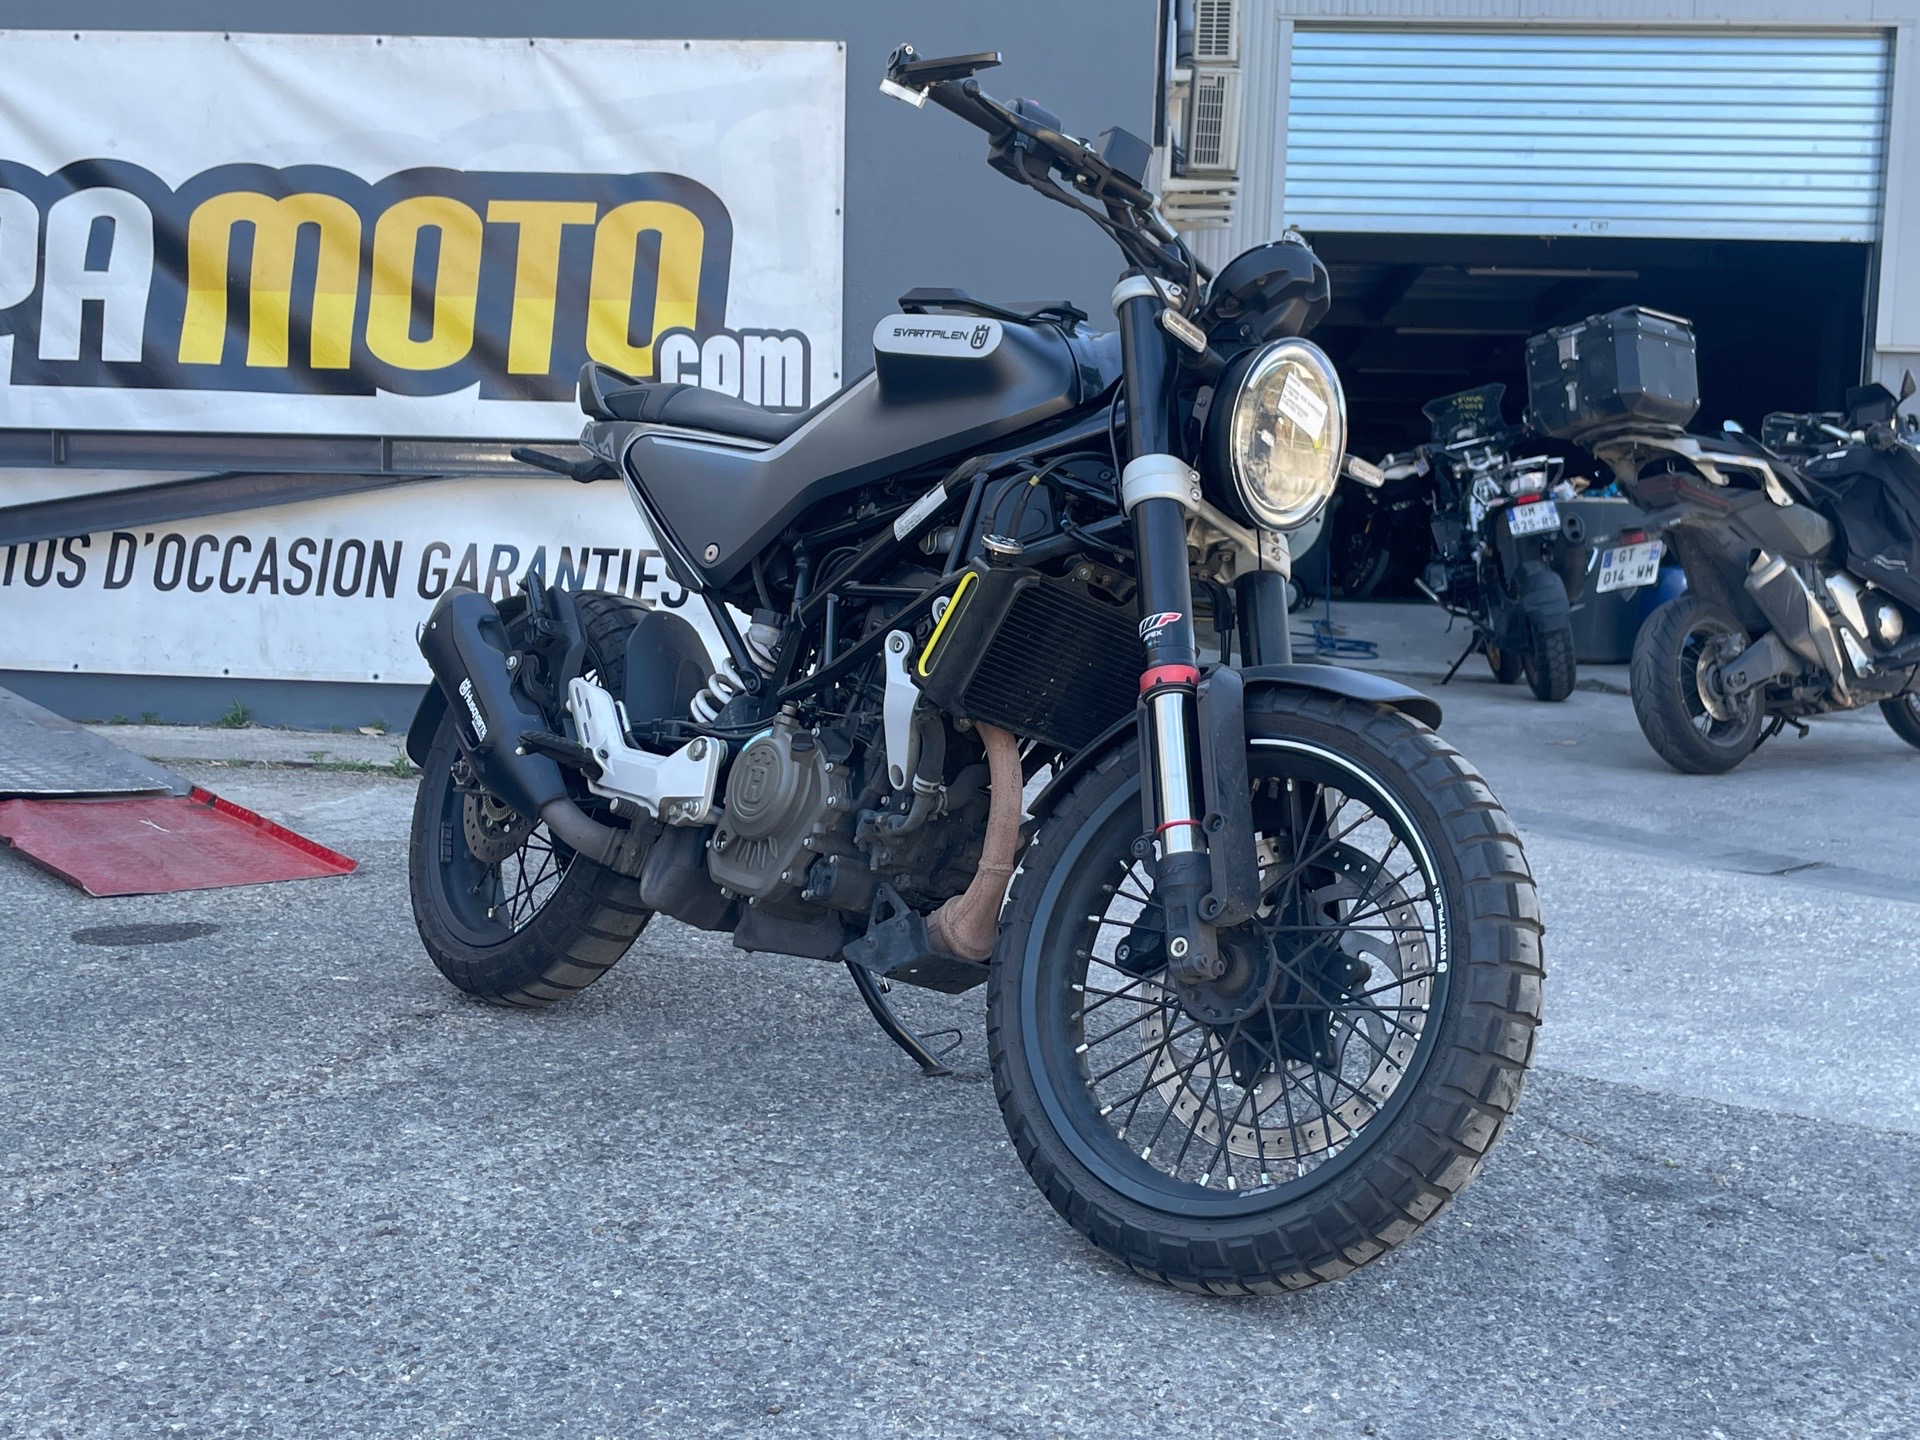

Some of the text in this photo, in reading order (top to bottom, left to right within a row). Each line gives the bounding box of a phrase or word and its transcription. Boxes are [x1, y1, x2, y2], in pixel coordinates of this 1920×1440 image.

[892, 328, 969, 341] SVARTPILEN
[103, 532, 403, 598] D'OCCASION
[417, 541, 691, 608] GARANTIES
